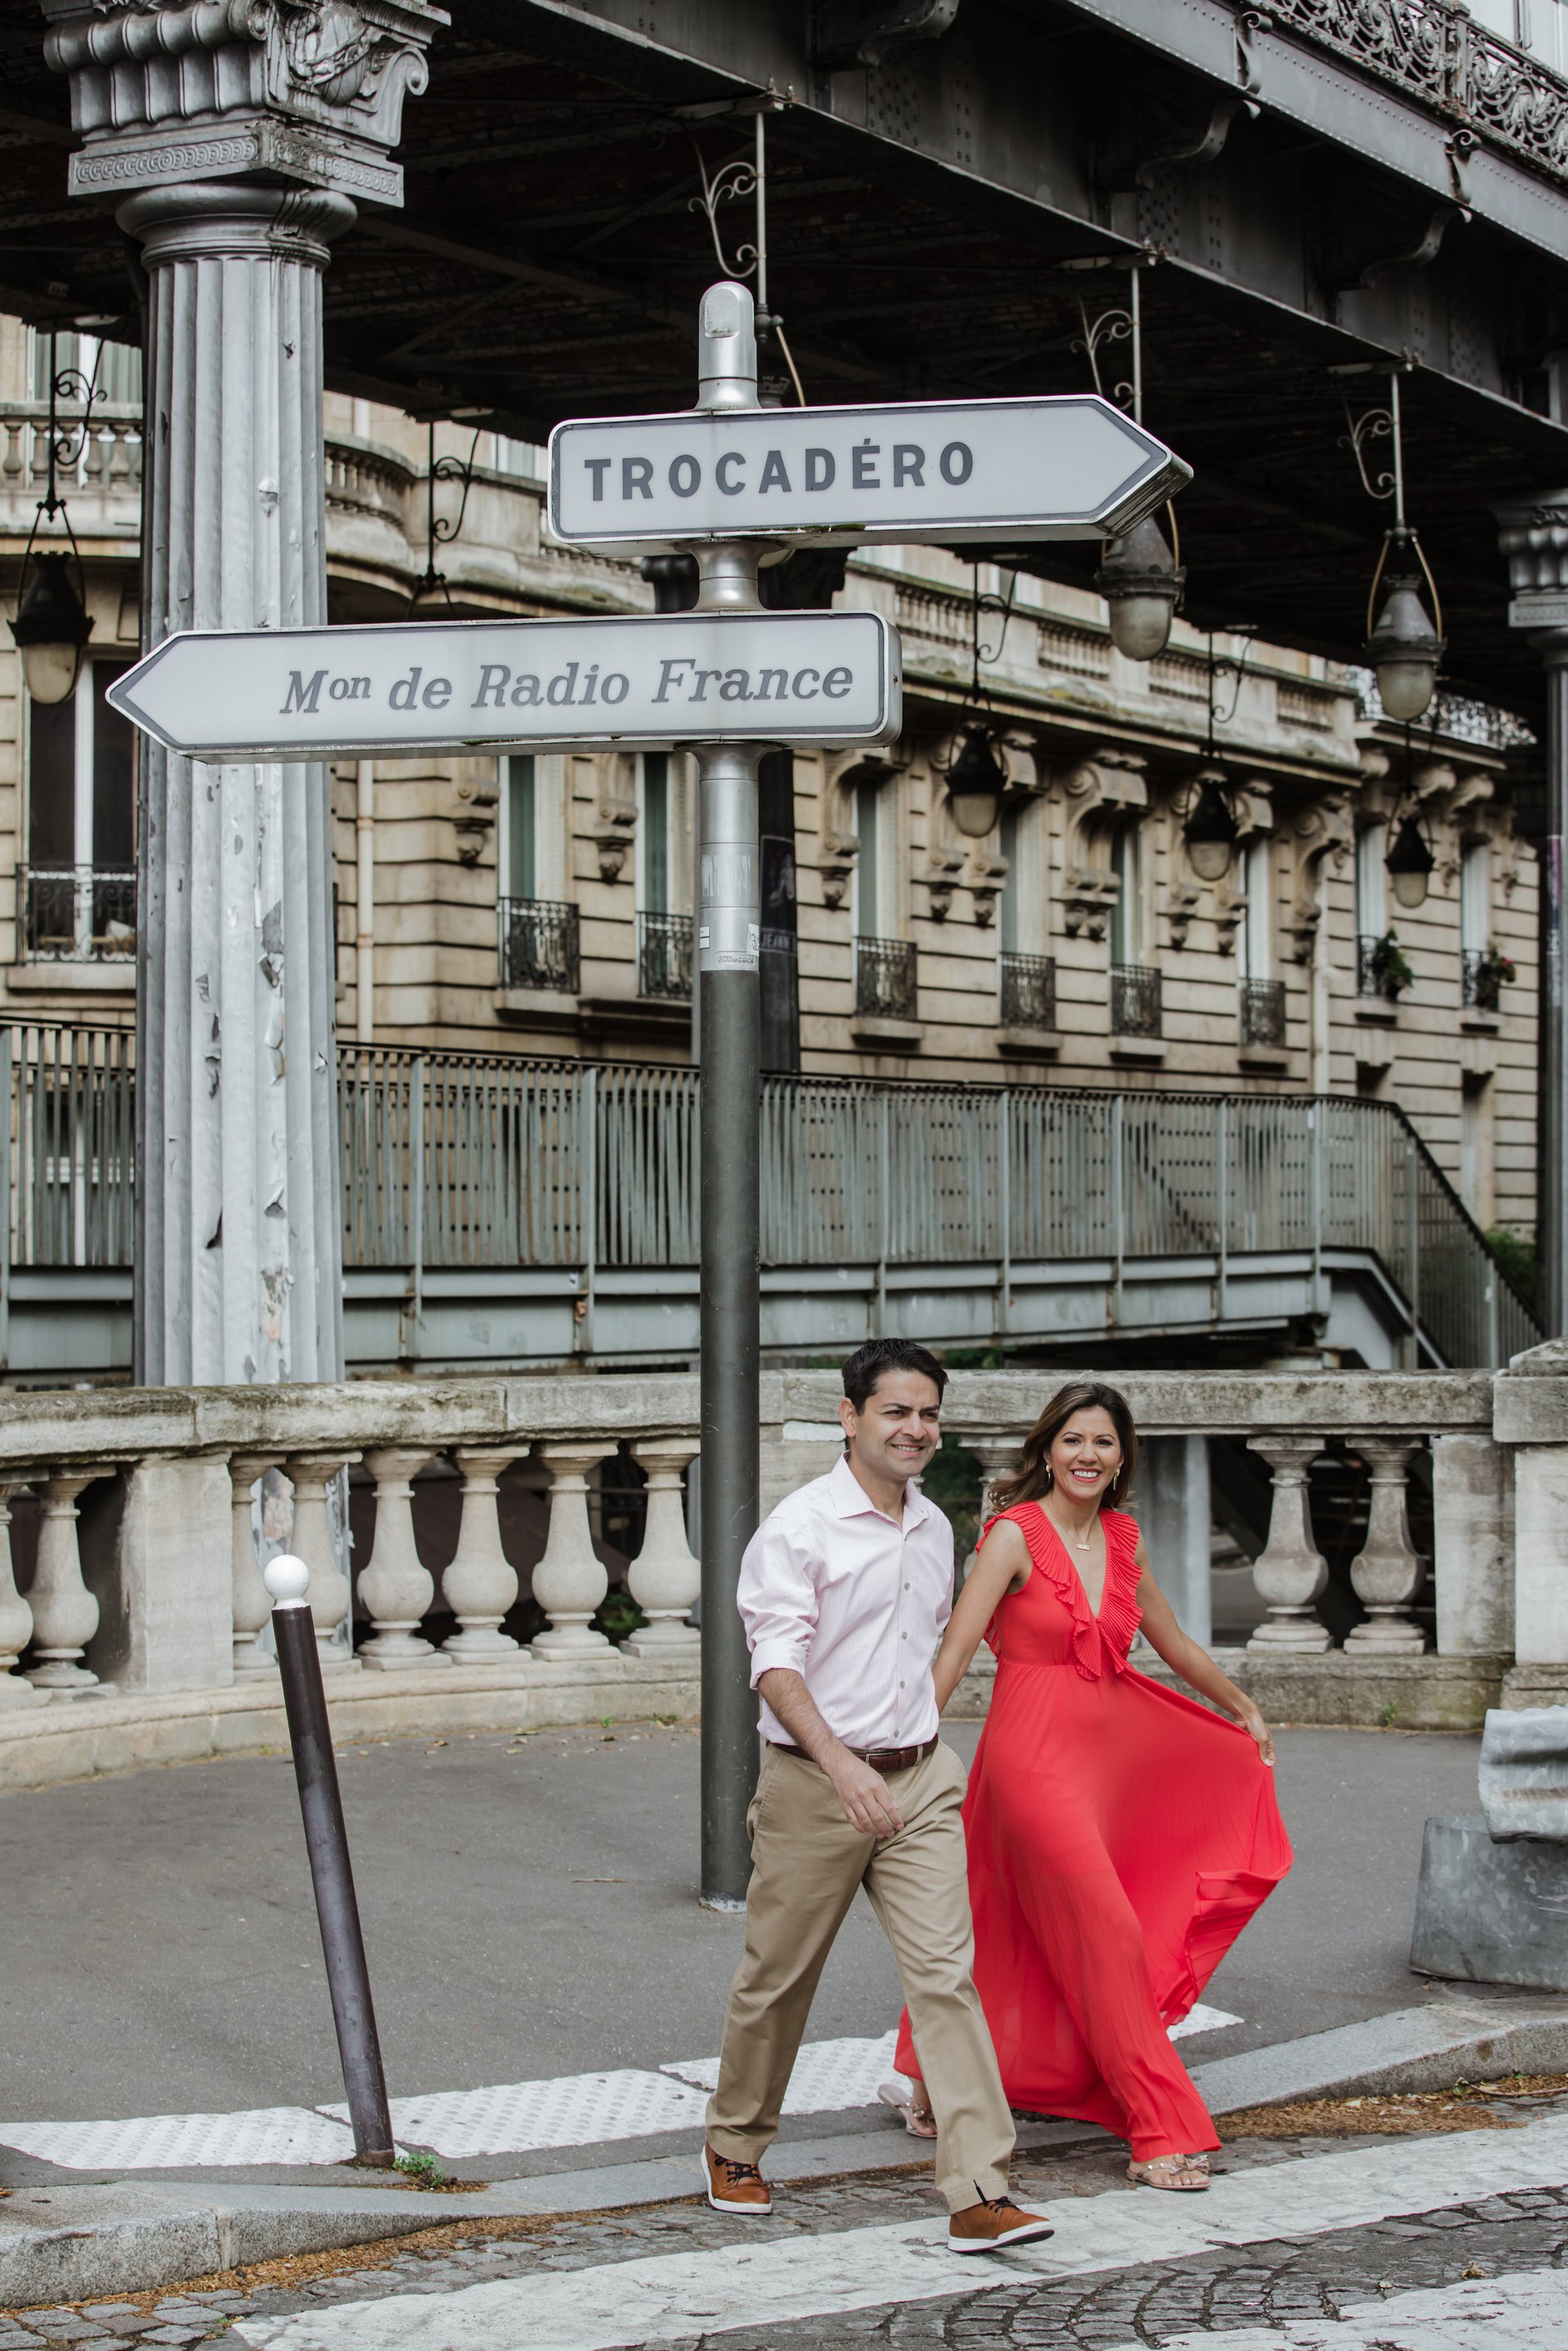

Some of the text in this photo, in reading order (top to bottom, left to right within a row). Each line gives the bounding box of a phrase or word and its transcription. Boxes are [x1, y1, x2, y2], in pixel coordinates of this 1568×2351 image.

[585, 439, 973, 501] TROCADÉRO
[390, 667, 452, 710] de
[471, 662, 629, 708] Radio
[652, 659, 853, 704] France
